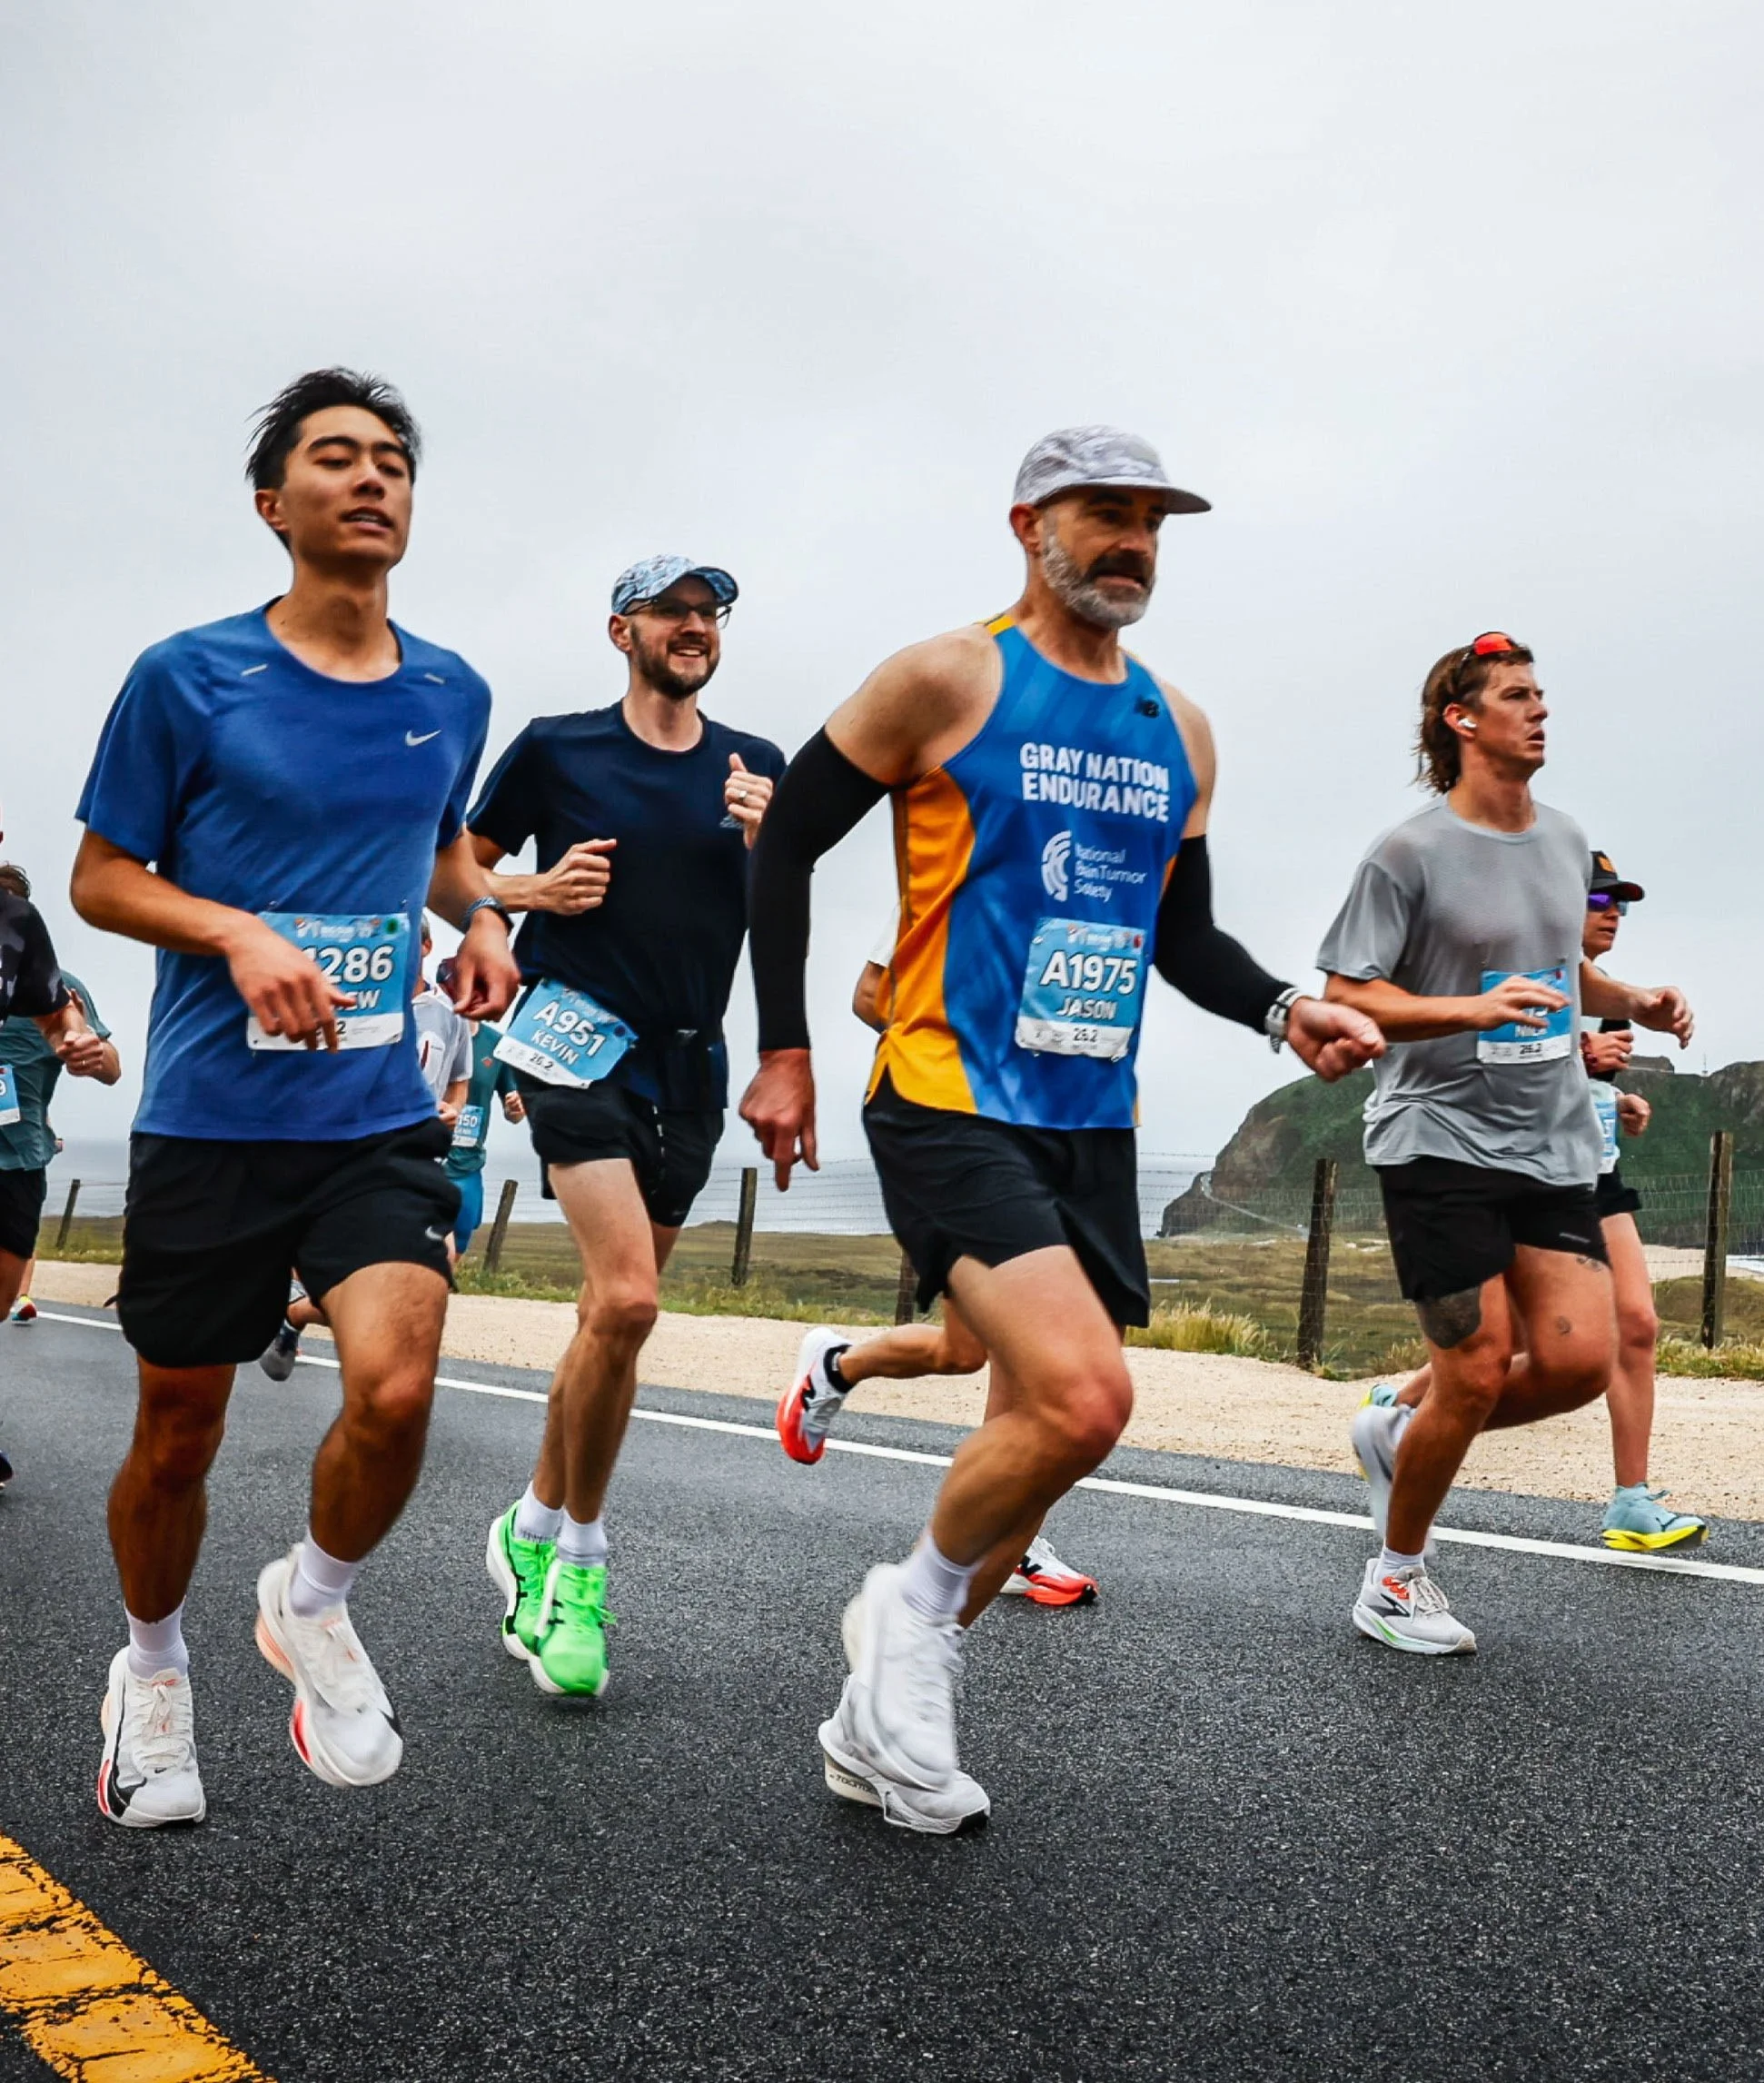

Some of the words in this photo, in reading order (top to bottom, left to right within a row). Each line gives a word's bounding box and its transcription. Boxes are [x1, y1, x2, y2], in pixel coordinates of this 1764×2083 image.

[1020, 742, 1084, 775] GRAY
[1086, 752, 1169, 792] NATION
[1023, 772, 1170, 823] ENDURANCE
[1075, 843, 1126, 864] National
[1099, 865, 1147, 884] Tumor
[1039, 950, 1138, 996] A1975
[532, 1000, 607, 1057] A951
[1056, 996, 1118, 1020] JASON
[530, 1028, 580, 1066] KEVIN
